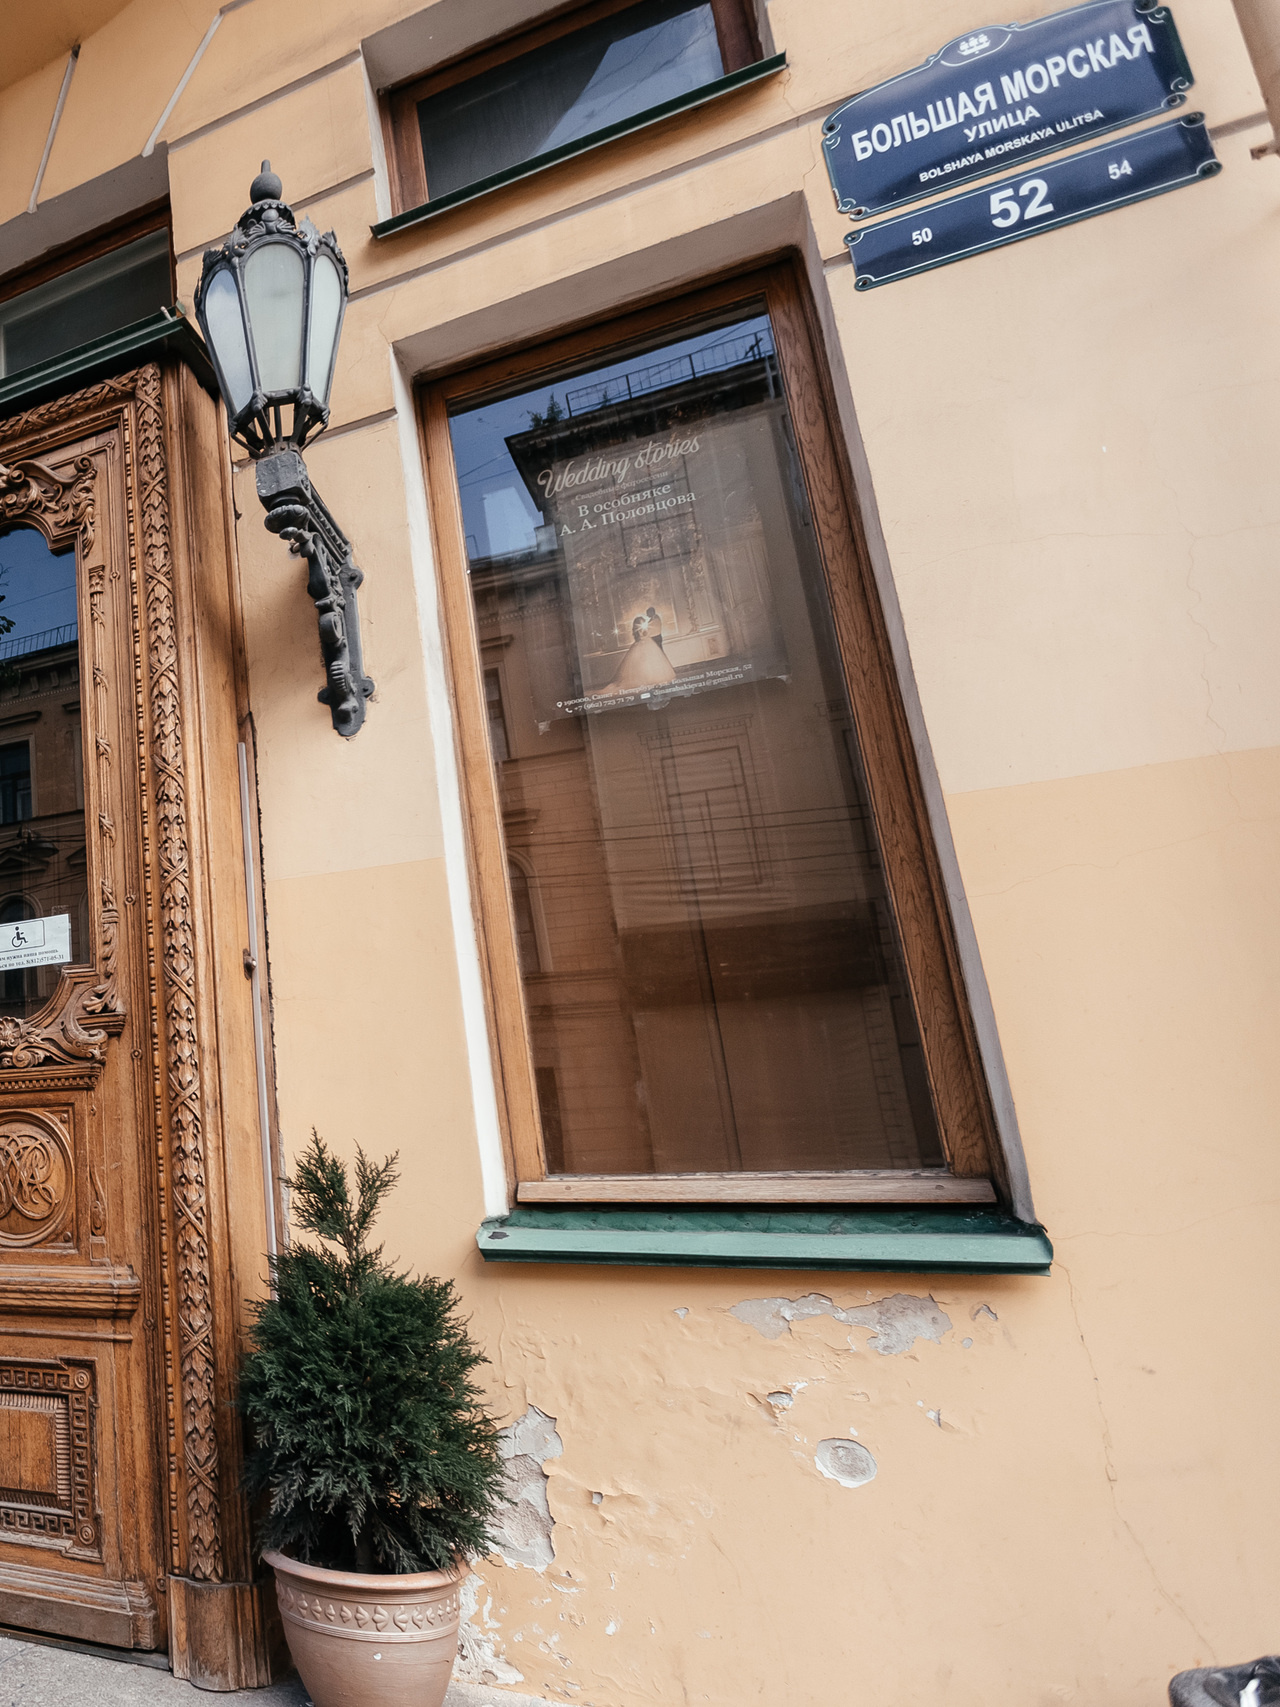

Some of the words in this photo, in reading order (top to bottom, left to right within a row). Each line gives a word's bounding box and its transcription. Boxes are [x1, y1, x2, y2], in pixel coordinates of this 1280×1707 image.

[851, 82, 997, 161] БОЛЬШАЯ
[1000, 23, 1155, 104] МОРСКАЯ
[963, 105, 1041, 142] УЛИЦА
[919, 152, 984, 182] BOLSHAYA
[984, 125, 1055, 159] MORSKAYA
[1056, 108, 1104, 133] ULITSA
[911, 227, 933, 246] 50
[989, 178, 1054, 228] 52
[1107, 159, 1133, 180] 54
[537, 456, 631, 498] Wedding
[634, 435, 700, 469] stories
[559, 523, 577, 537] А.
[580, 518, 598, 532] А.
[601, 490, 697, 526] Половцова
[577, 504, 590, 518] В
[593, 483, 672, 514] особняке
